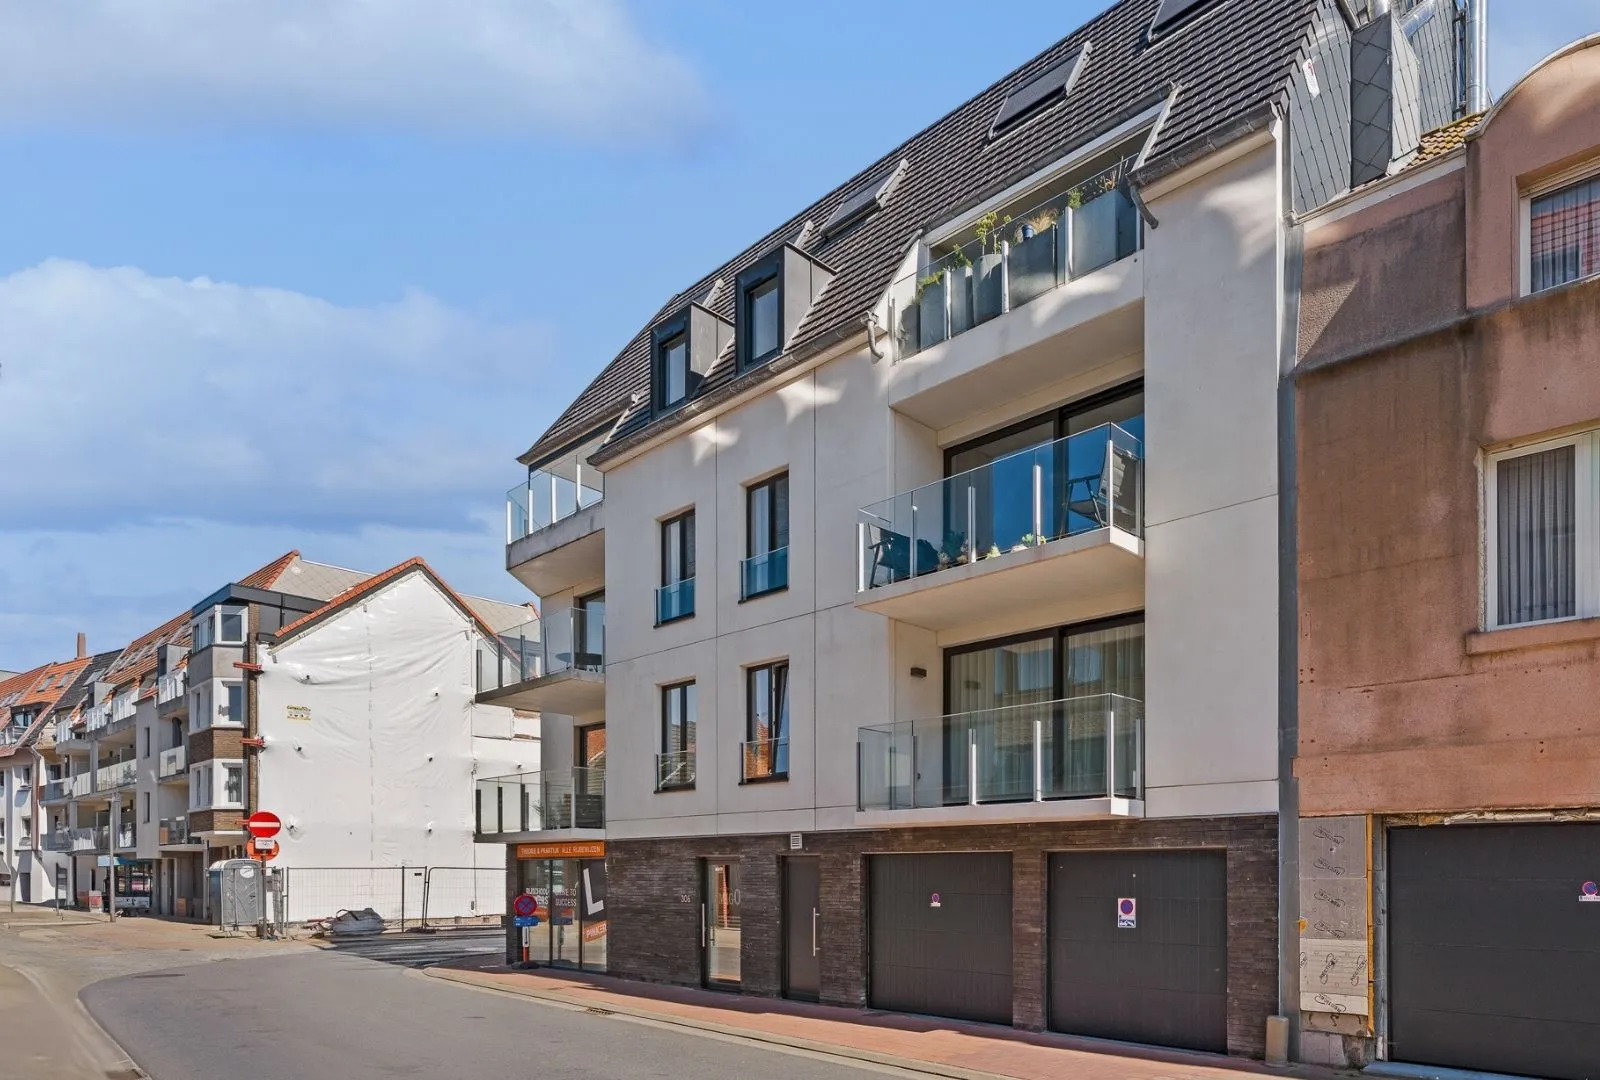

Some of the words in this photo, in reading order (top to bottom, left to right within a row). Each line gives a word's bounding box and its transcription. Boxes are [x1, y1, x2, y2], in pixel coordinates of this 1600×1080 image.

[583, 868, 604, 915] L
[555, 898, 577, 907] SUCCESS
[681, 894, 691, 903] 306
